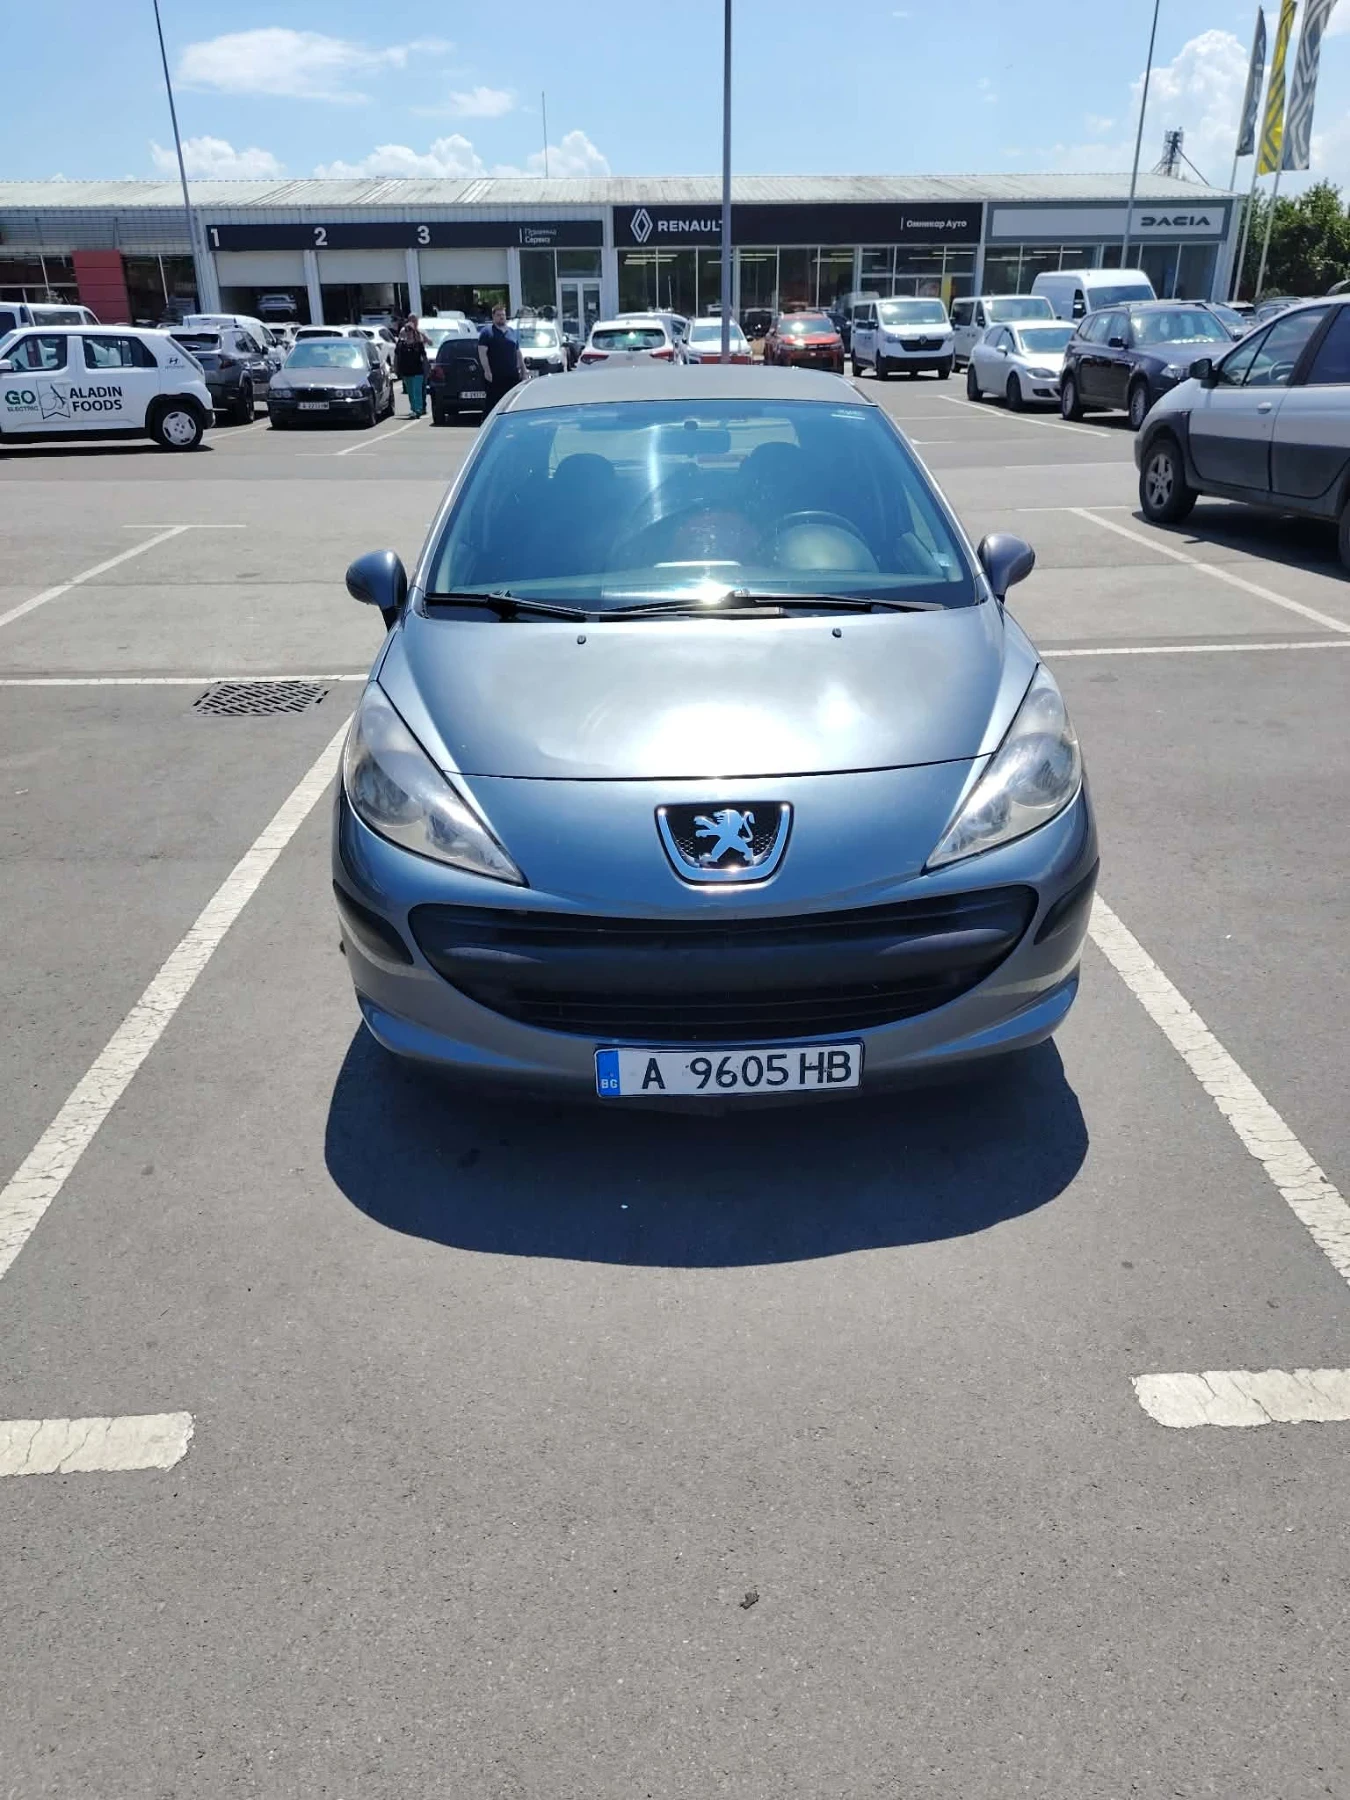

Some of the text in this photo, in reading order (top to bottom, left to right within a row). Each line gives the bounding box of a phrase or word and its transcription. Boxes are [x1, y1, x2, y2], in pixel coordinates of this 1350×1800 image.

[1141, 216, 1211, 226] DACIA
[211, 228, 220, 247] 1
[313, 227, 328, 246] 2
[417, 225, 431, 244] 3
[5, 390, 36, 405] GO
[69, 386, 123, 399] ALADIN
[72, 399, 122, 412] FOODS
[641, 1050, 852, 1089] A 9605 HB
[601, 1078, 618, 1089] BG
